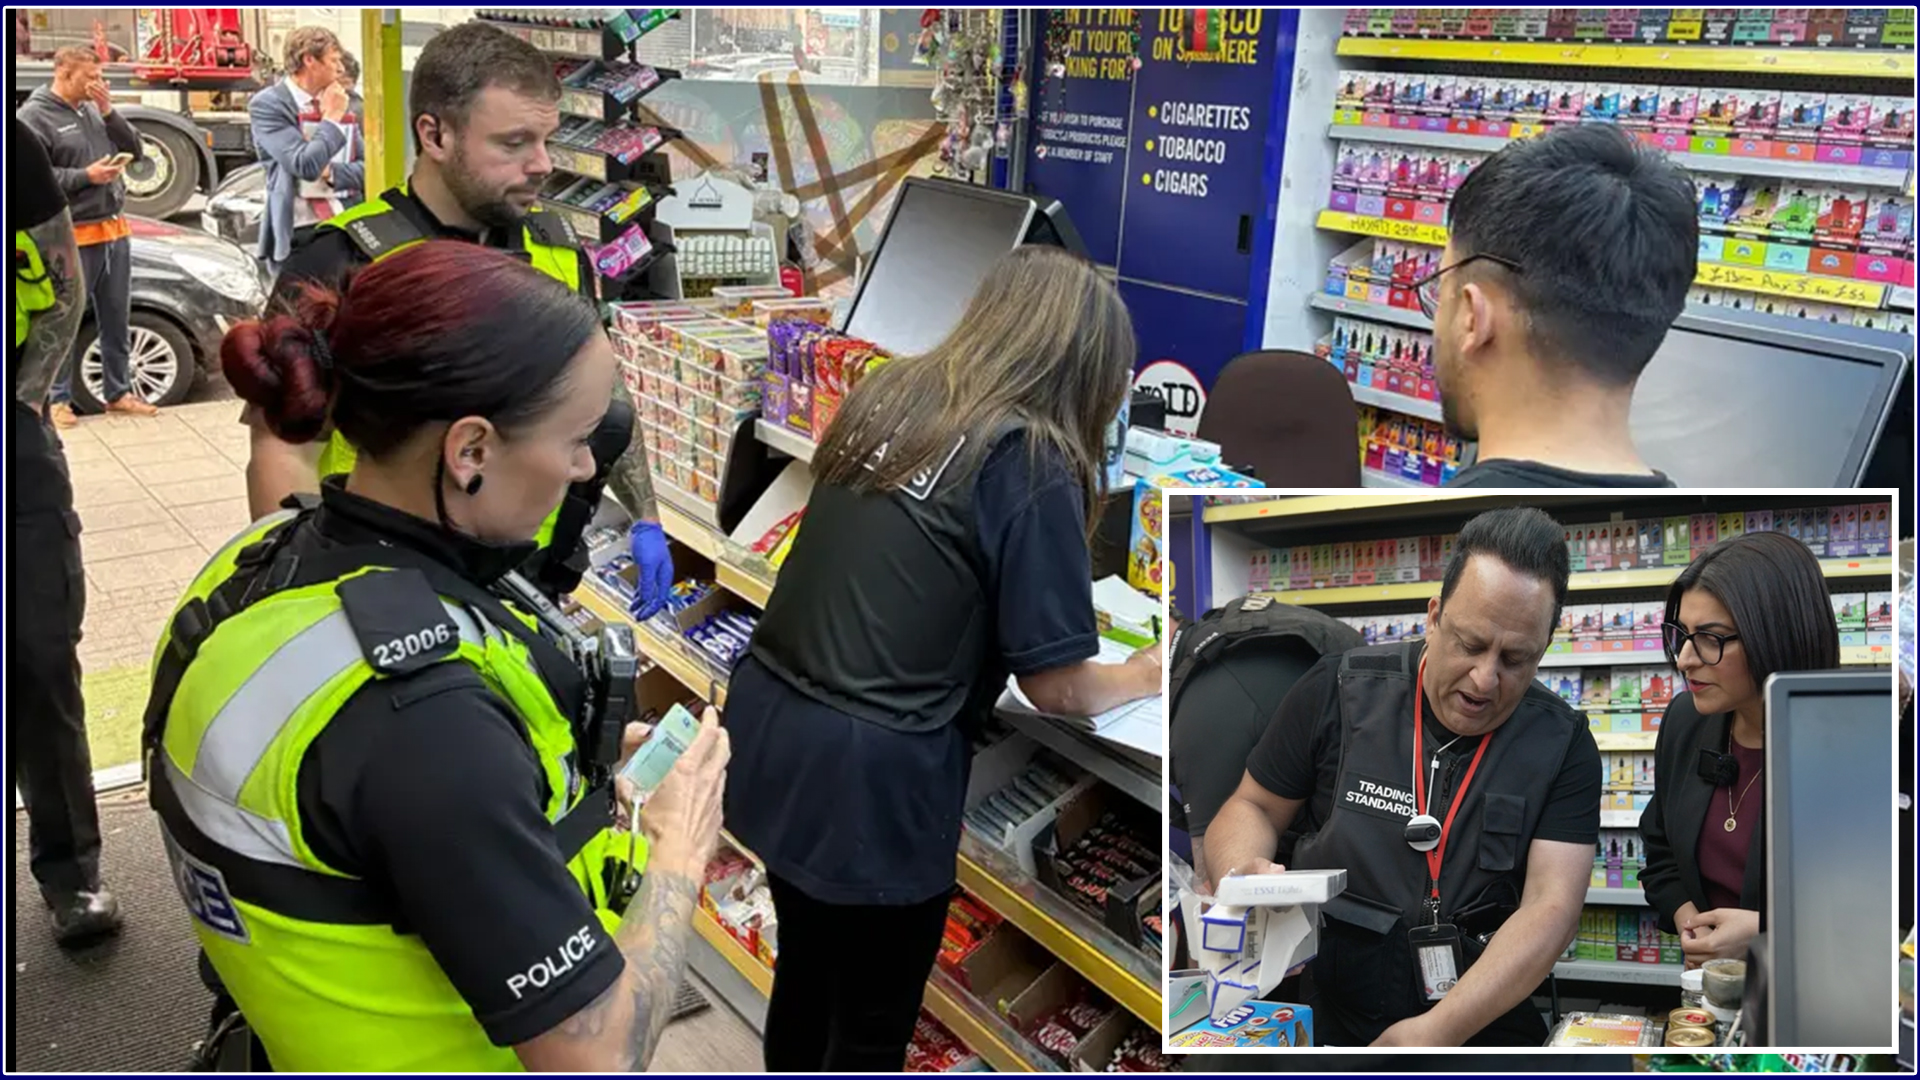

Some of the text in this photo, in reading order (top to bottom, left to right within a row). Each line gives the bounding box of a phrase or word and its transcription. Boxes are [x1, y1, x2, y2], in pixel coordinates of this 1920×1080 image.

[1152, 36, 1174, 60] ON
[1160, 101, 1251, 130] CIGARETTES
[1157, 135, 1226, 164] TOBACCO
[1154, 169, 1208, 197] CIGARS
[373, 623, 450, 667] 23006
[1345, 791, 1418, 818] STANDARDS
[1359, 780, 1414, 804] TRADING
[1254, 886, 1276, 896] ESSE
[506, 925, 597, 999] POLICE
